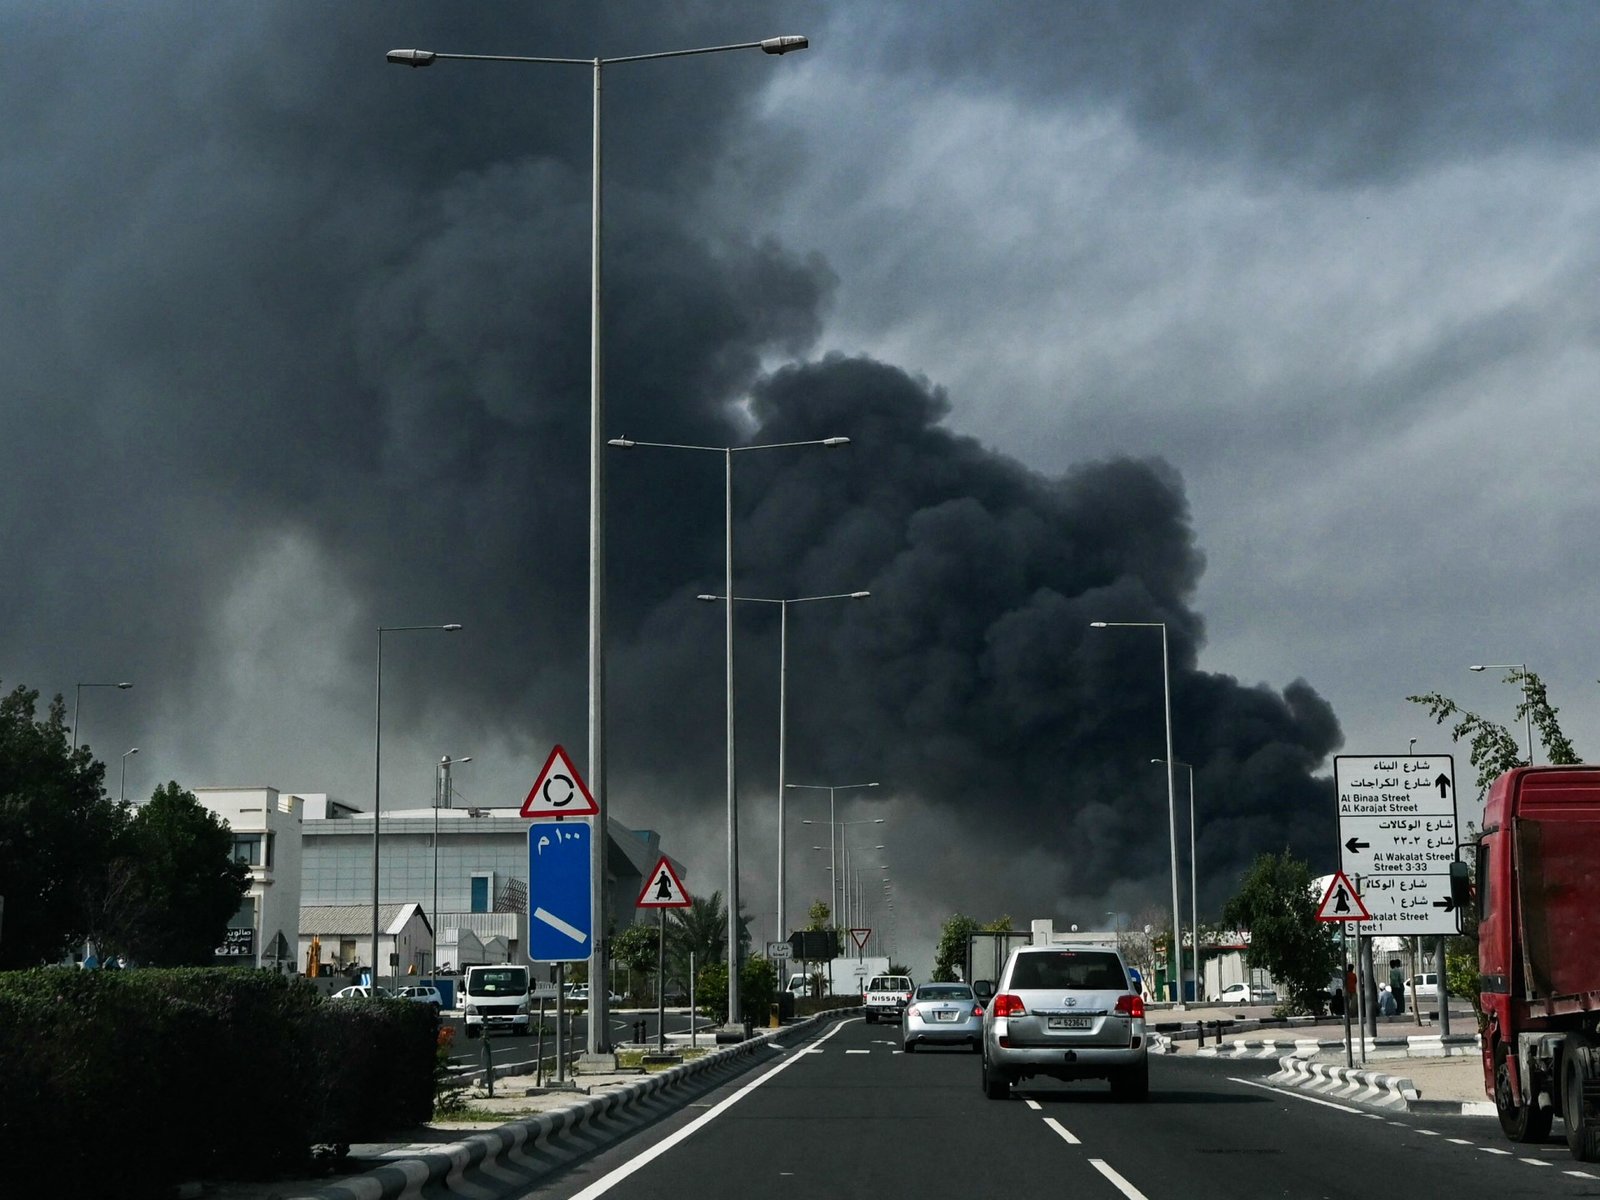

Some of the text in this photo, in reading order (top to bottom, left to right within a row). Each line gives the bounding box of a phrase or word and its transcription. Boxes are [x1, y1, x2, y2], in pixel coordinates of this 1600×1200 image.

[1374, 761, 1430, 772] شارع البناء
[1351, 778, 1431, 789] شارع الكراجات
[1341, 794, 1410, 802] Al Binaa Street
[1341, 804, 1418, 813] Al Karajat Street
[1379, 820, 1453, 831] شارع الوكالات
[538, 836, 550, 856] م
[1427, 836, 1454, 848] شارع
[1374, 853, 1454, 861] Al Wakalat Street
[1374, 863, 1428, 871] Street 3-33
[1400, 880, 1427, 891] شارع
[1391, 896, 1428, 908] شارع ١
[1369, 913, 1429, 921] akalat Street
[1347, 923, 1383, 931] Sreet 1
